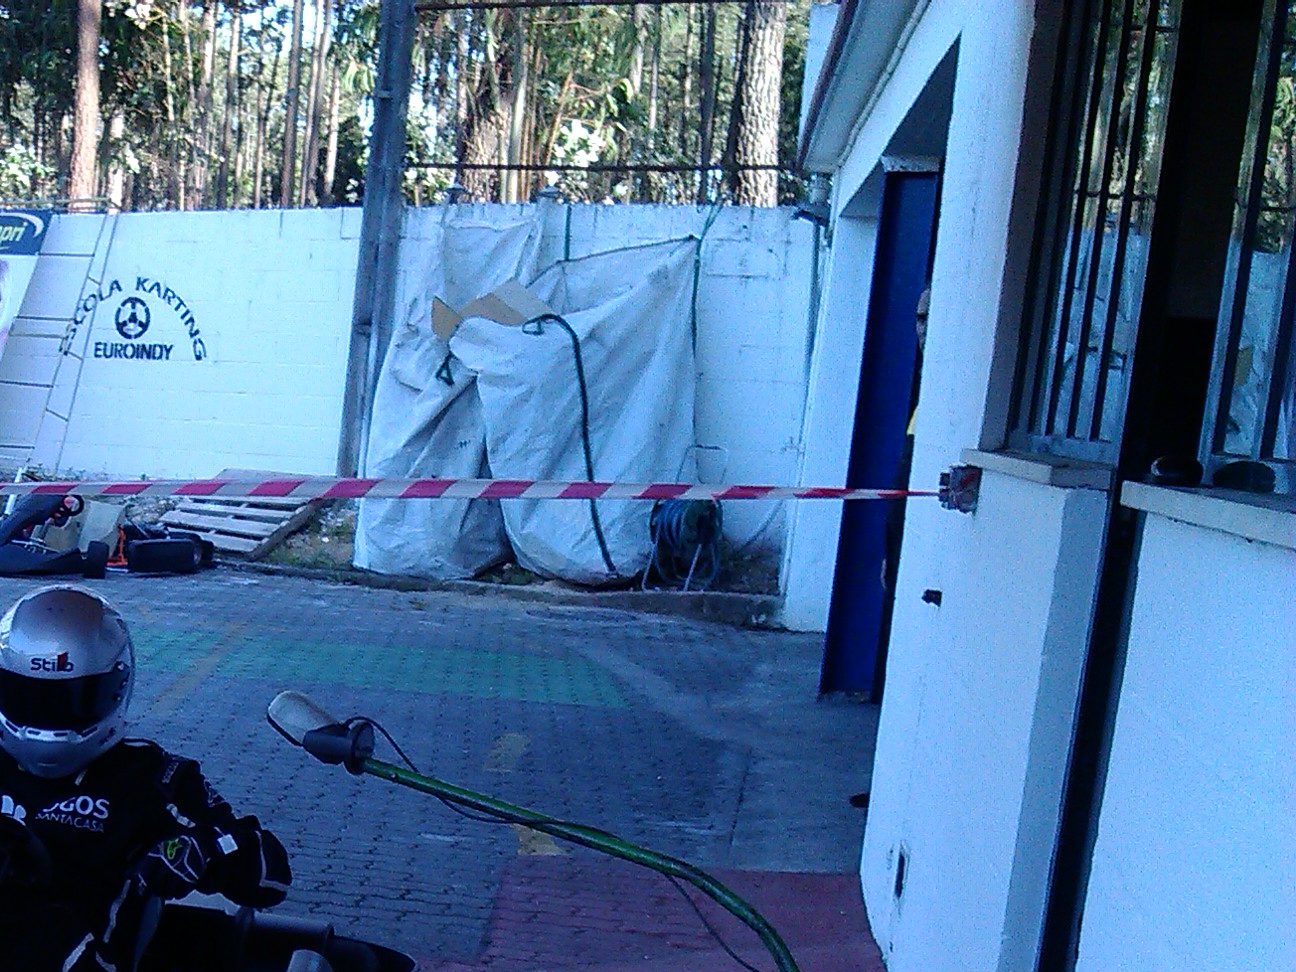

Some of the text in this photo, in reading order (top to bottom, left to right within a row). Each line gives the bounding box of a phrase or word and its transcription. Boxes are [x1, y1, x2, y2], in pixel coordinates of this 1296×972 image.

[136, 276, 207, 360] KARTING
[94, 342, 174, 360] EUROINDY
[30, 651, 74, 672] Stilo
